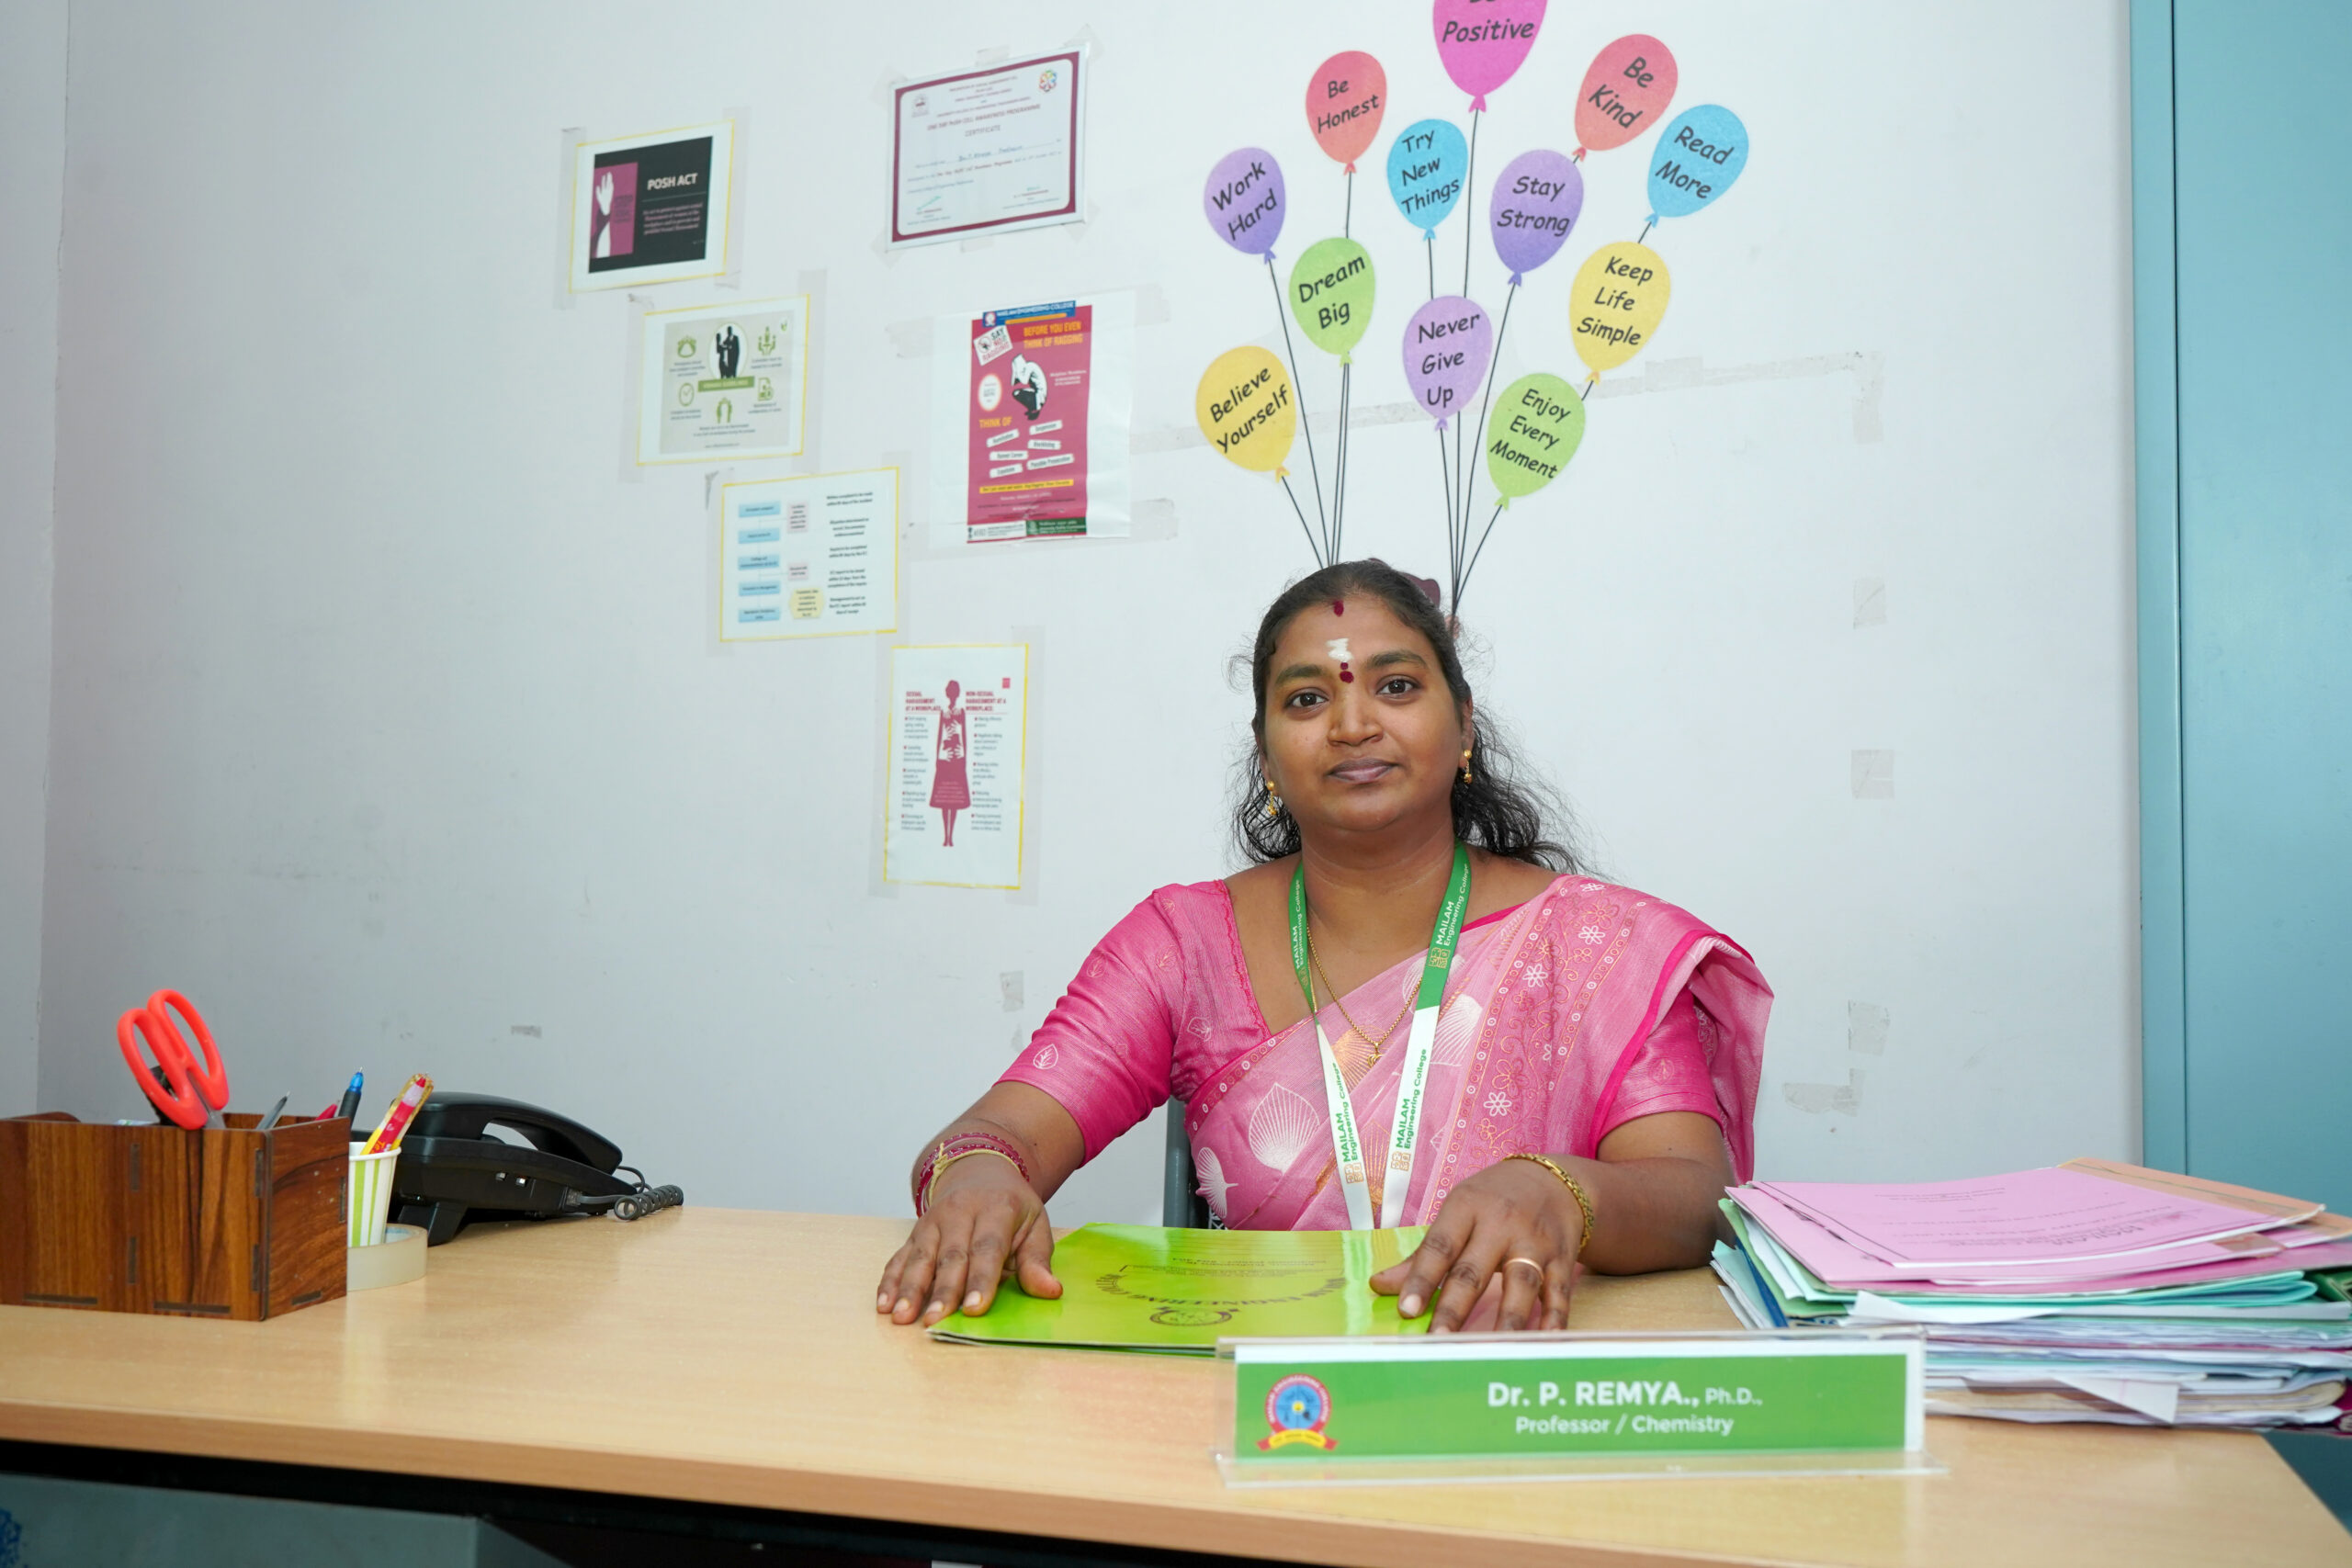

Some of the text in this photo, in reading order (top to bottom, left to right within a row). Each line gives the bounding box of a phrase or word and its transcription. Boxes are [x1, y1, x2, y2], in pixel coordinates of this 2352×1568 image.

[1442, 18, 1534, 43] Positive
[1327, 79, 1350, 99] Be
[1623, 56, 1655, 88] Be
[1317, 94, 1380, 133] Honest
[1588, 84, 1643, 129] Kind
[1402, 130, 1435, 153] Try
[1674, 125, 1735, 165] Read
[647, 173, 698, 191] POSH ACT
[1212, 161, 1266, 211] Work
[1402, 157, 1441, 186] New
[1512, 175, 1566, 202] Stay
[1655, 160, 1712, 199] More
[1401, 178, 1460, 214] Things
[1227, 187, 1278, 241] Hard
[1497, 209, 1570, 237] Strong
[1298, 256, 1366, 303] Dream
[1604, 255, 1654, 287] Keep
[1317, 302, 1351, 330] Big
[1594, 287, 1635, 310] Life
[1023, 321, 1081, 337] BEFORE YOU EVEN
[1419, 313, 1480, 344] Never
[1577, 317, 1642, 346] Simple
[1421, 352, 1464, 375] Give
[1209, 367, 1271, 423] Believe
[1427, 386, 1453, 409] Up
[1521, 389, 1571, 423] Enjoy
[1216, 384, 1288, 454] Yourself
[1510, 414, 1560, 450] Every
[1489, 439, 1558, 479] Moment
[1443, 863, 1469, 946] Engineering College
[1436, 901, 1455, 945] MAILAM
[1292, 925, 1301, 969] MAILAM
[1332, 1063, 1358, 1161] Engineering College
[1404, 1049, 1427, 1149] Engineering College
[1335, 1113, 1351, 1163] MAILAM
[1396, 1098, 1410, 1148] MAILAM
[1487, 1382, 1530, 1407] Dr.
[1539, 1382, 1566, 1406] P.
[1575, 1381, 1700, 1409] REMYA.,
[1516, 1415, 1735, 1437] Professor / Chemistry
